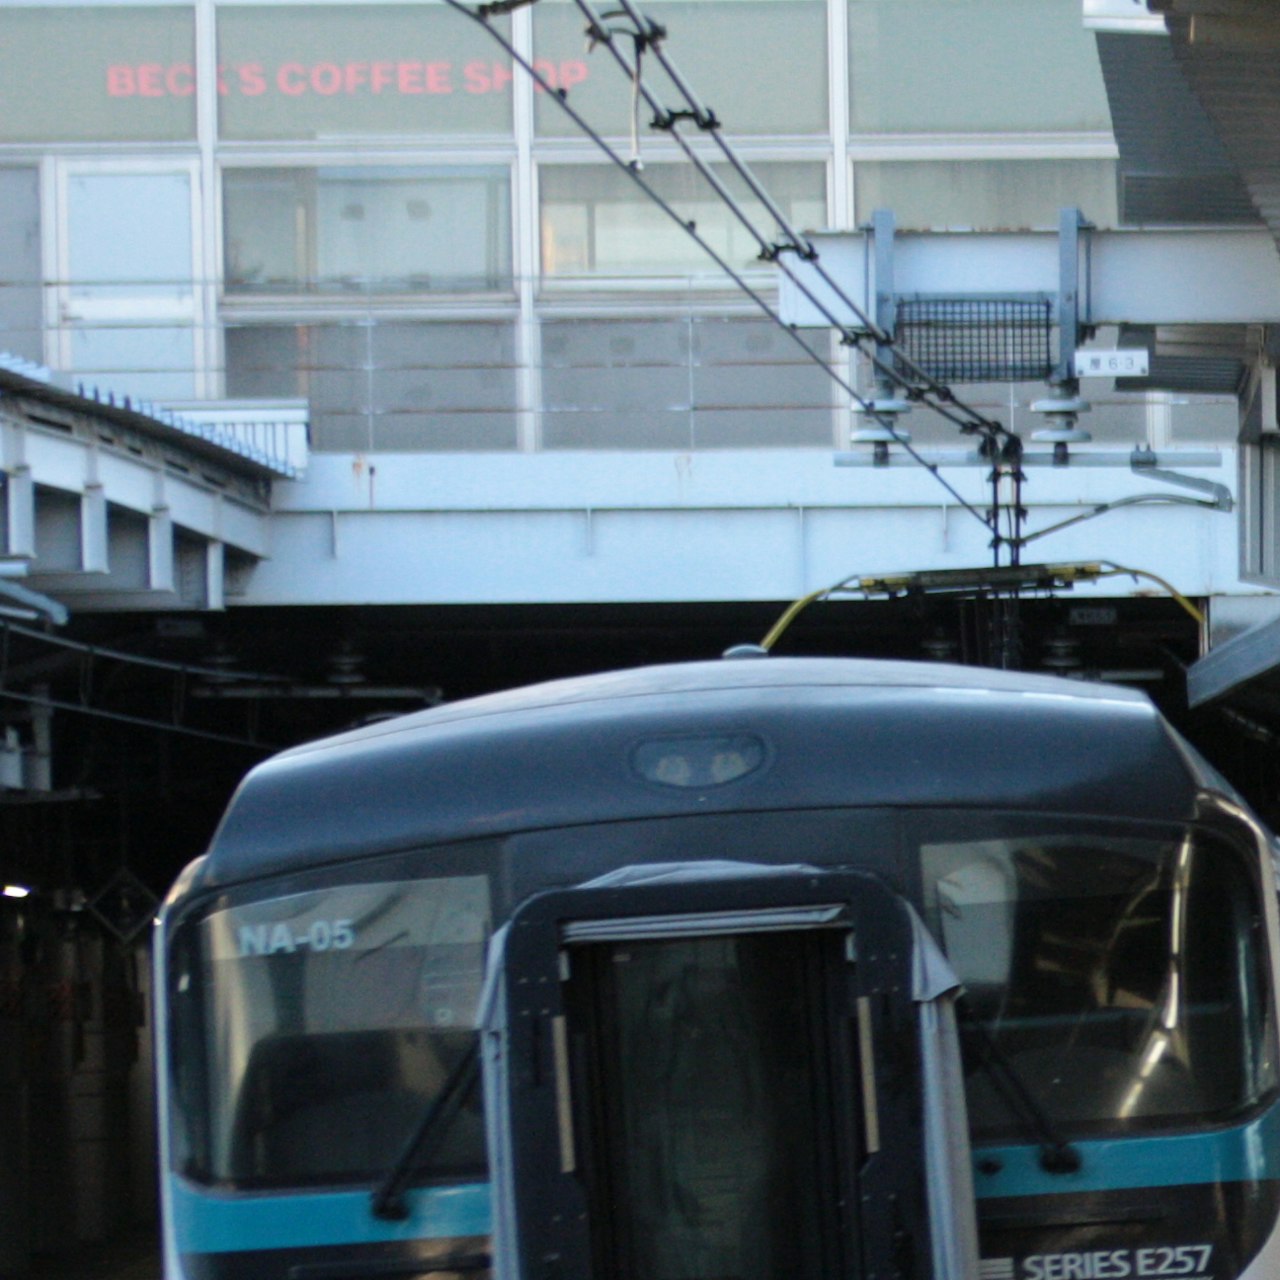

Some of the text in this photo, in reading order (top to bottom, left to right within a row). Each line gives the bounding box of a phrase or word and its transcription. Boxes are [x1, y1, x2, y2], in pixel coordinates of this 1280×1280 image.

[276, 62, 453, 97] COFFEE
[239, 920, 355, 955] NA-05
[1136, 1245, 1213, 1275] E257
